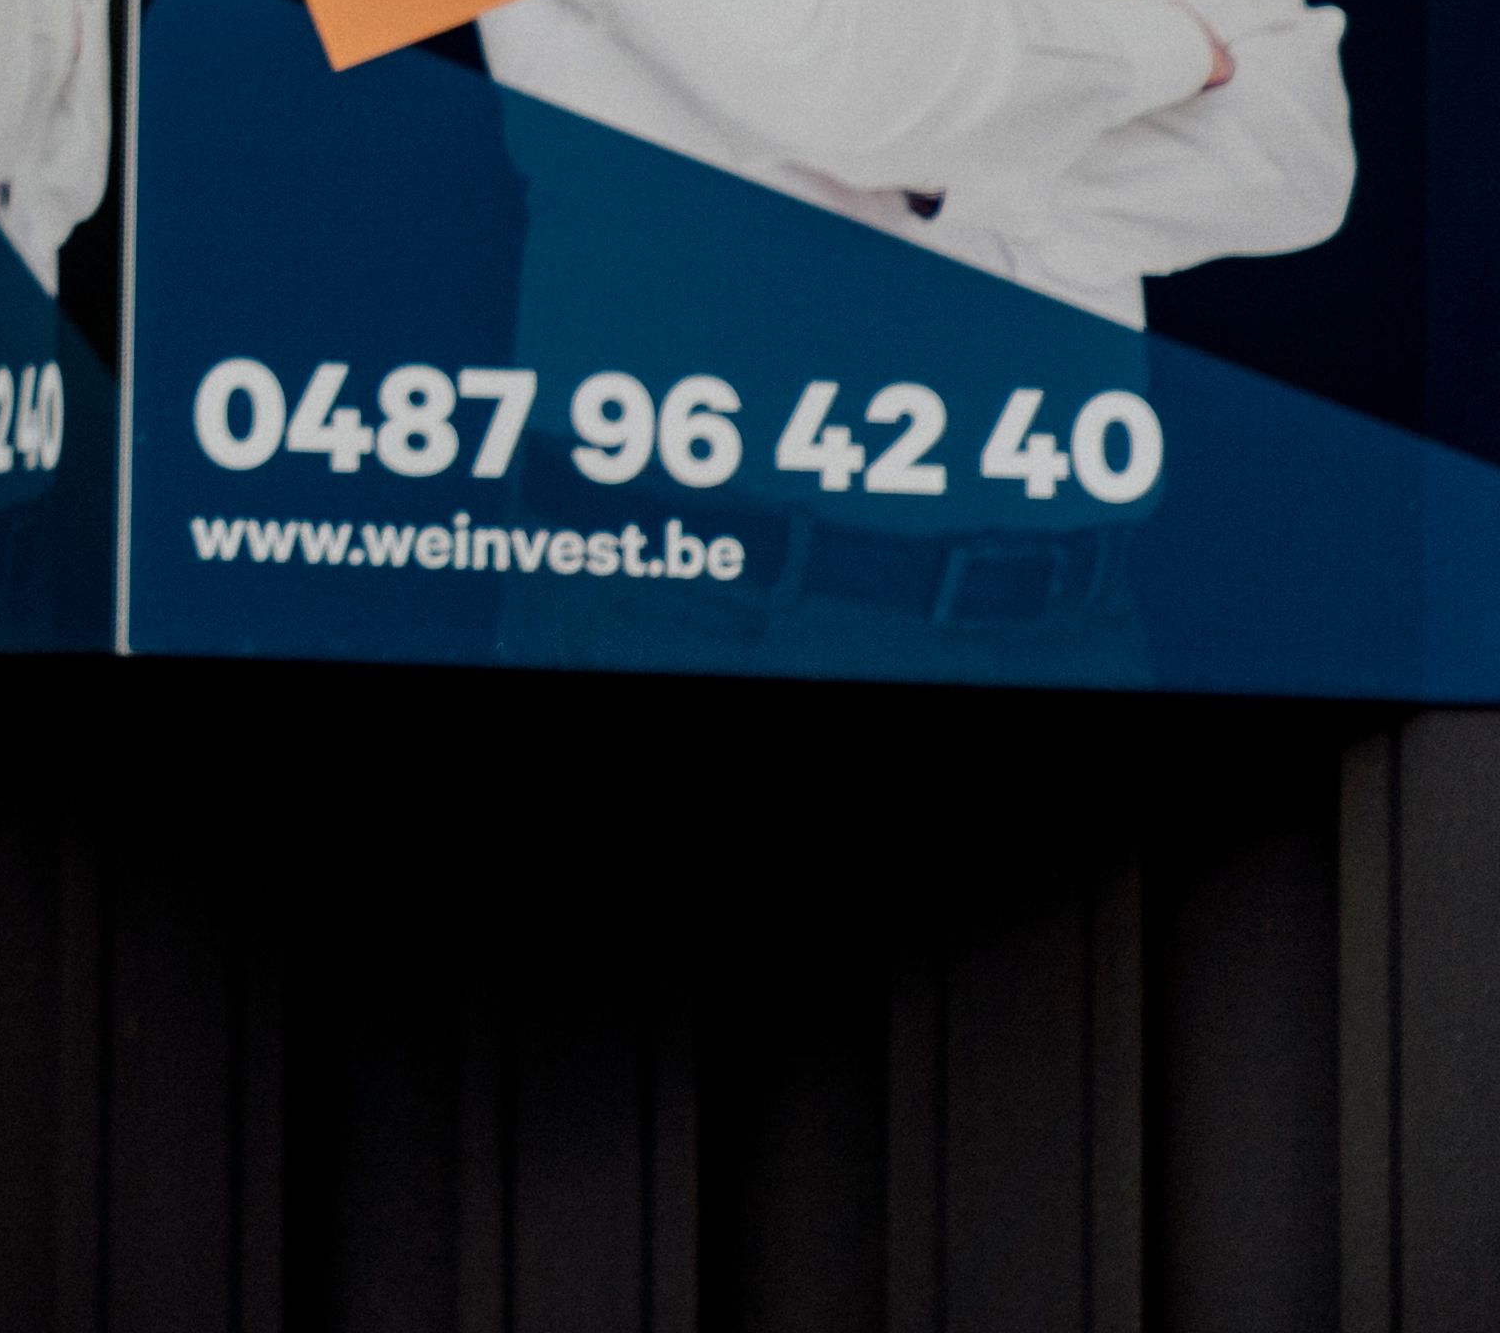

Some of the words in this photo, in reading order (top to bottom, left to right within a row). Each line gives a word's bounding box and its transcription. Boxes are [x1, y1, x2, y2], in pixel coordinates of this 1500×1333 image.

[15, 361, 65, 471] 40
[193, 356, 538, 480] 0487
[570, 371, 743, 489] 96
[775, 380, 948, 496] 42
[980, 387, 1164, 505] 40
[190, 511, 746, 582] www.weinvest.be
